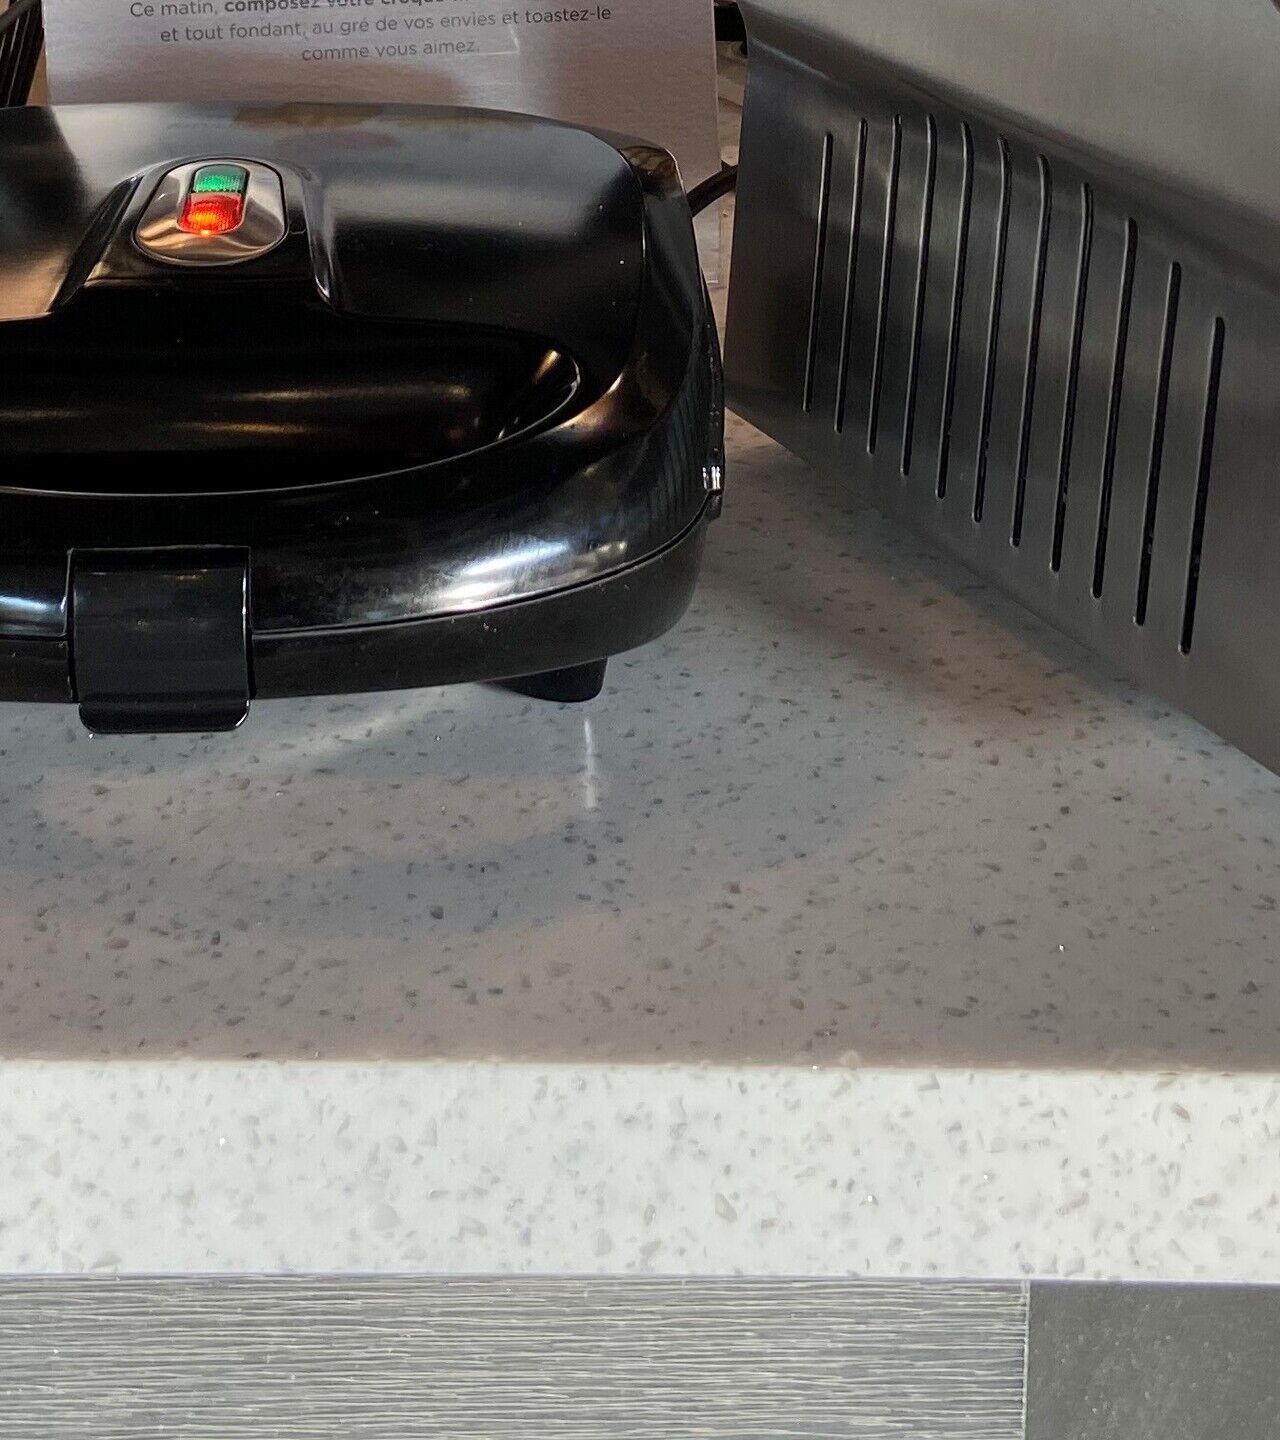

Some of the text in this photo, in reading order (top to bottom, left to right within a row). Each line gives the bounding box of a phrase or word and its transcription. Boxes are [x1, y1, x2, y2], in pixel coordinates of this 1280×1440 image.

[130, 2, 155, 17] Ce
[161, 0, 218, 16] matin,
[160, 6, 611, 42] et tout fondant, au gré de vos envies et toastez-le
[301, 46, 369, 61] comme
[375, 44, 417, 57] vous
